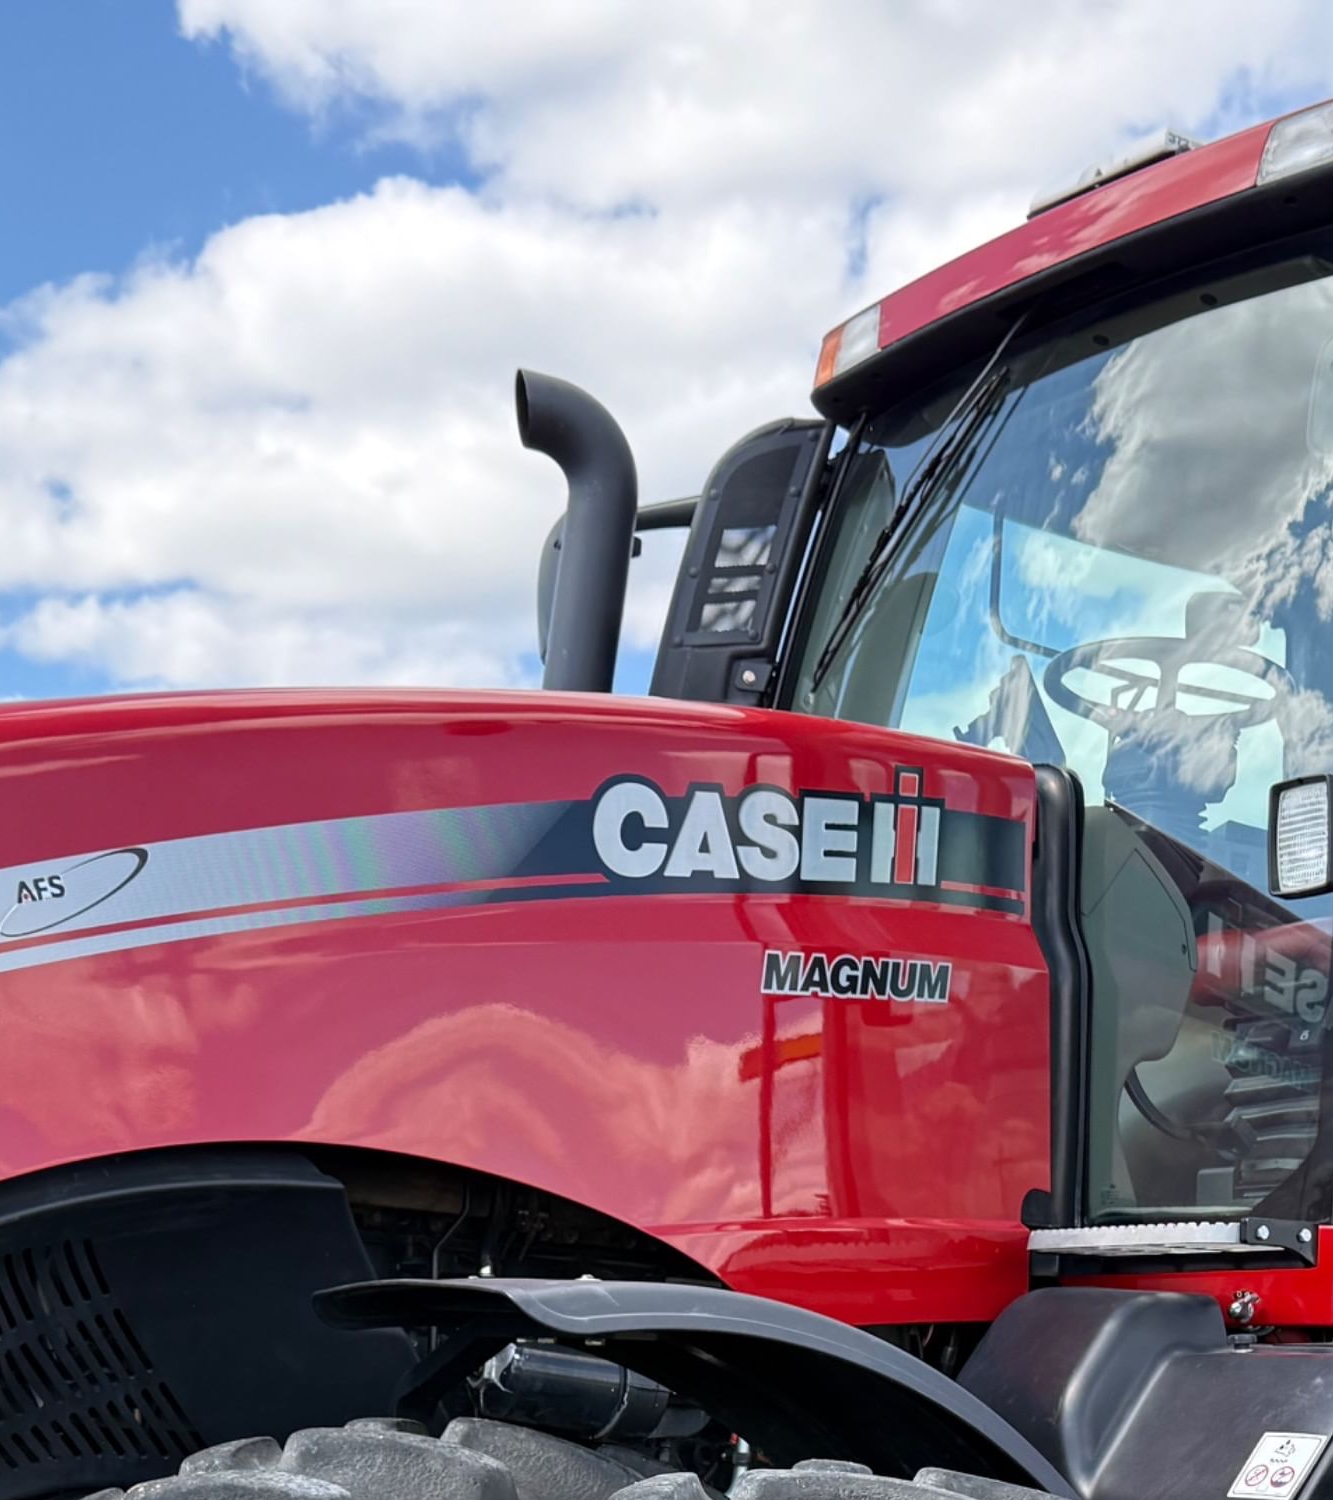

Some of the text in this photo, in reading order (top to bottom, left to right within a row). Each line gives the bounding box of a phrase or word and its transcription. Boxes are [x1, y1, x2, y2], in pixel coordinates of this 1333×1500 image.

[593, 782, 858, 882] CASE
[16, 874, 66, 905] AFS
[760, 950, 952, 1002] MAGNUM
